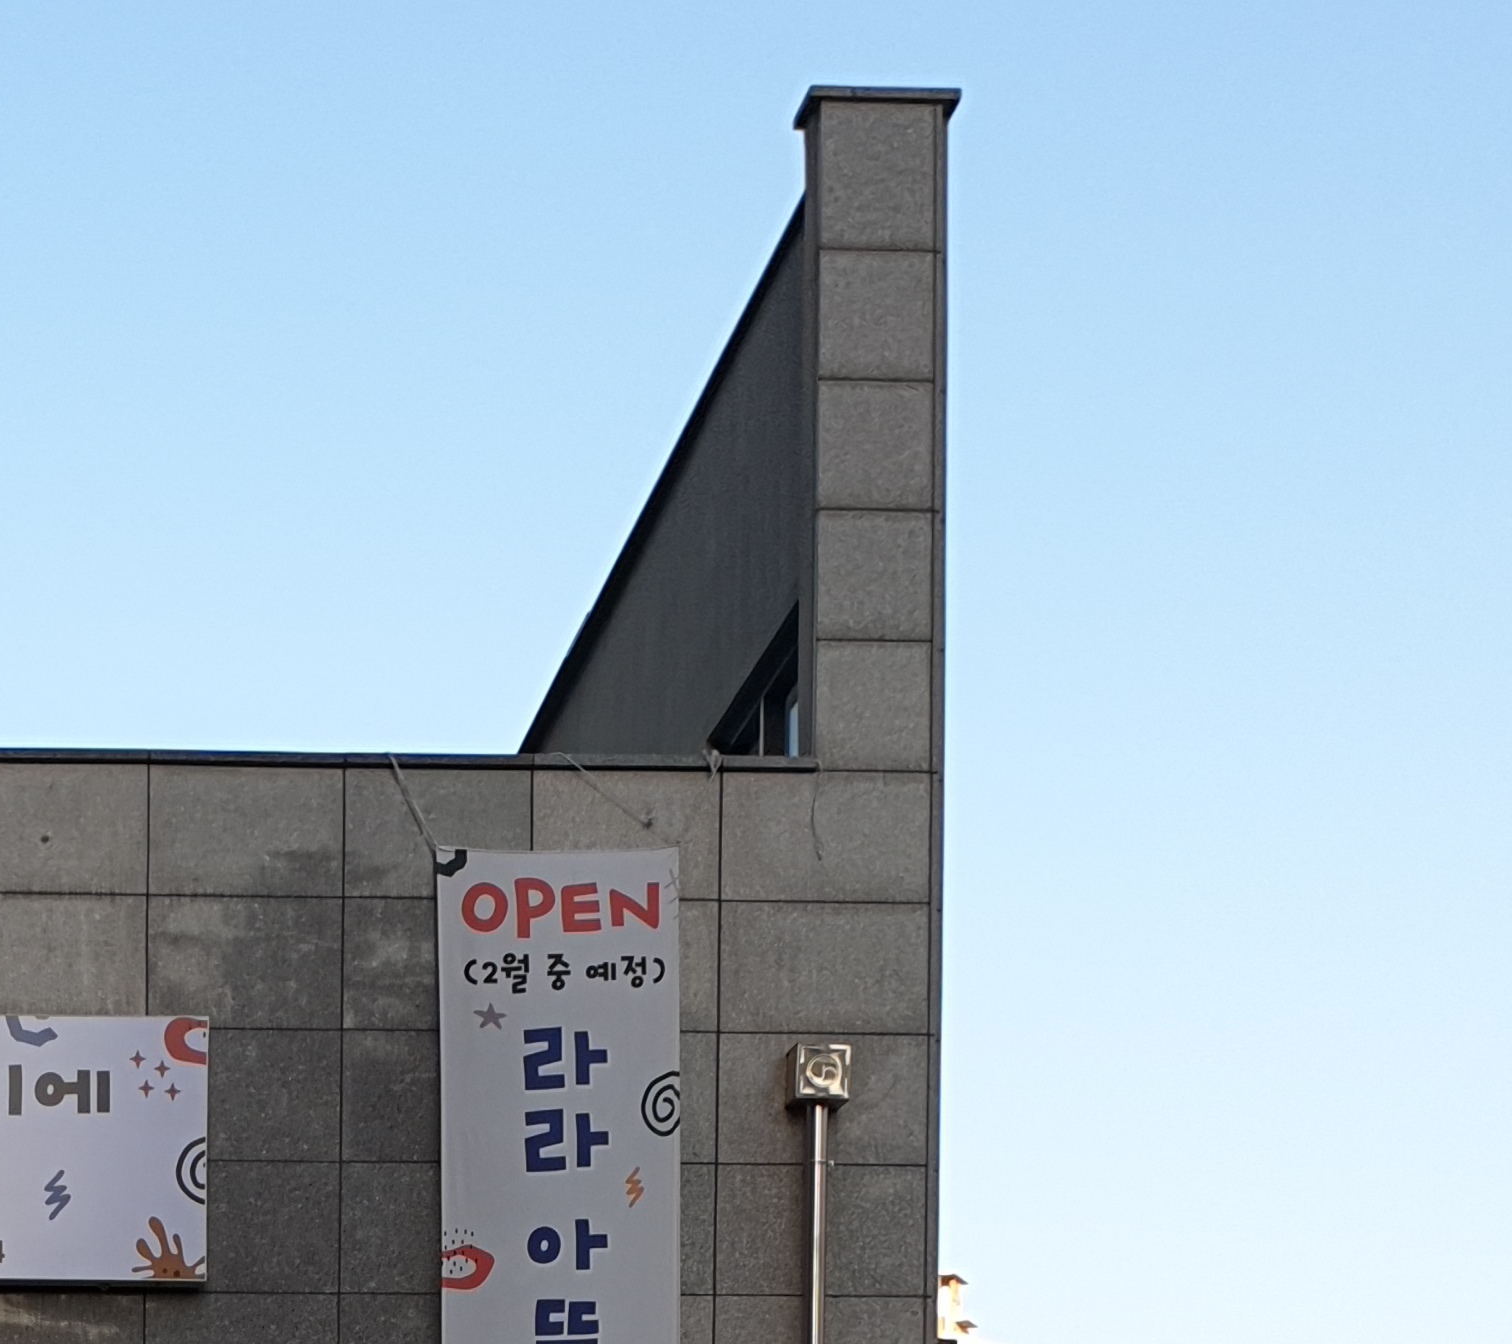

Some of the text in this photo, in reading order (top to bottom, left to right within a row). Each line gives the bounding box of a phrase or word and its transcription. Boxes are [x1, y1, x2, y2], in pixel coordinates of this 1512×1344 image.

[461, 877, 660, 939] OPEN
[464, 953, 666, 995] (2월 중 예정)
